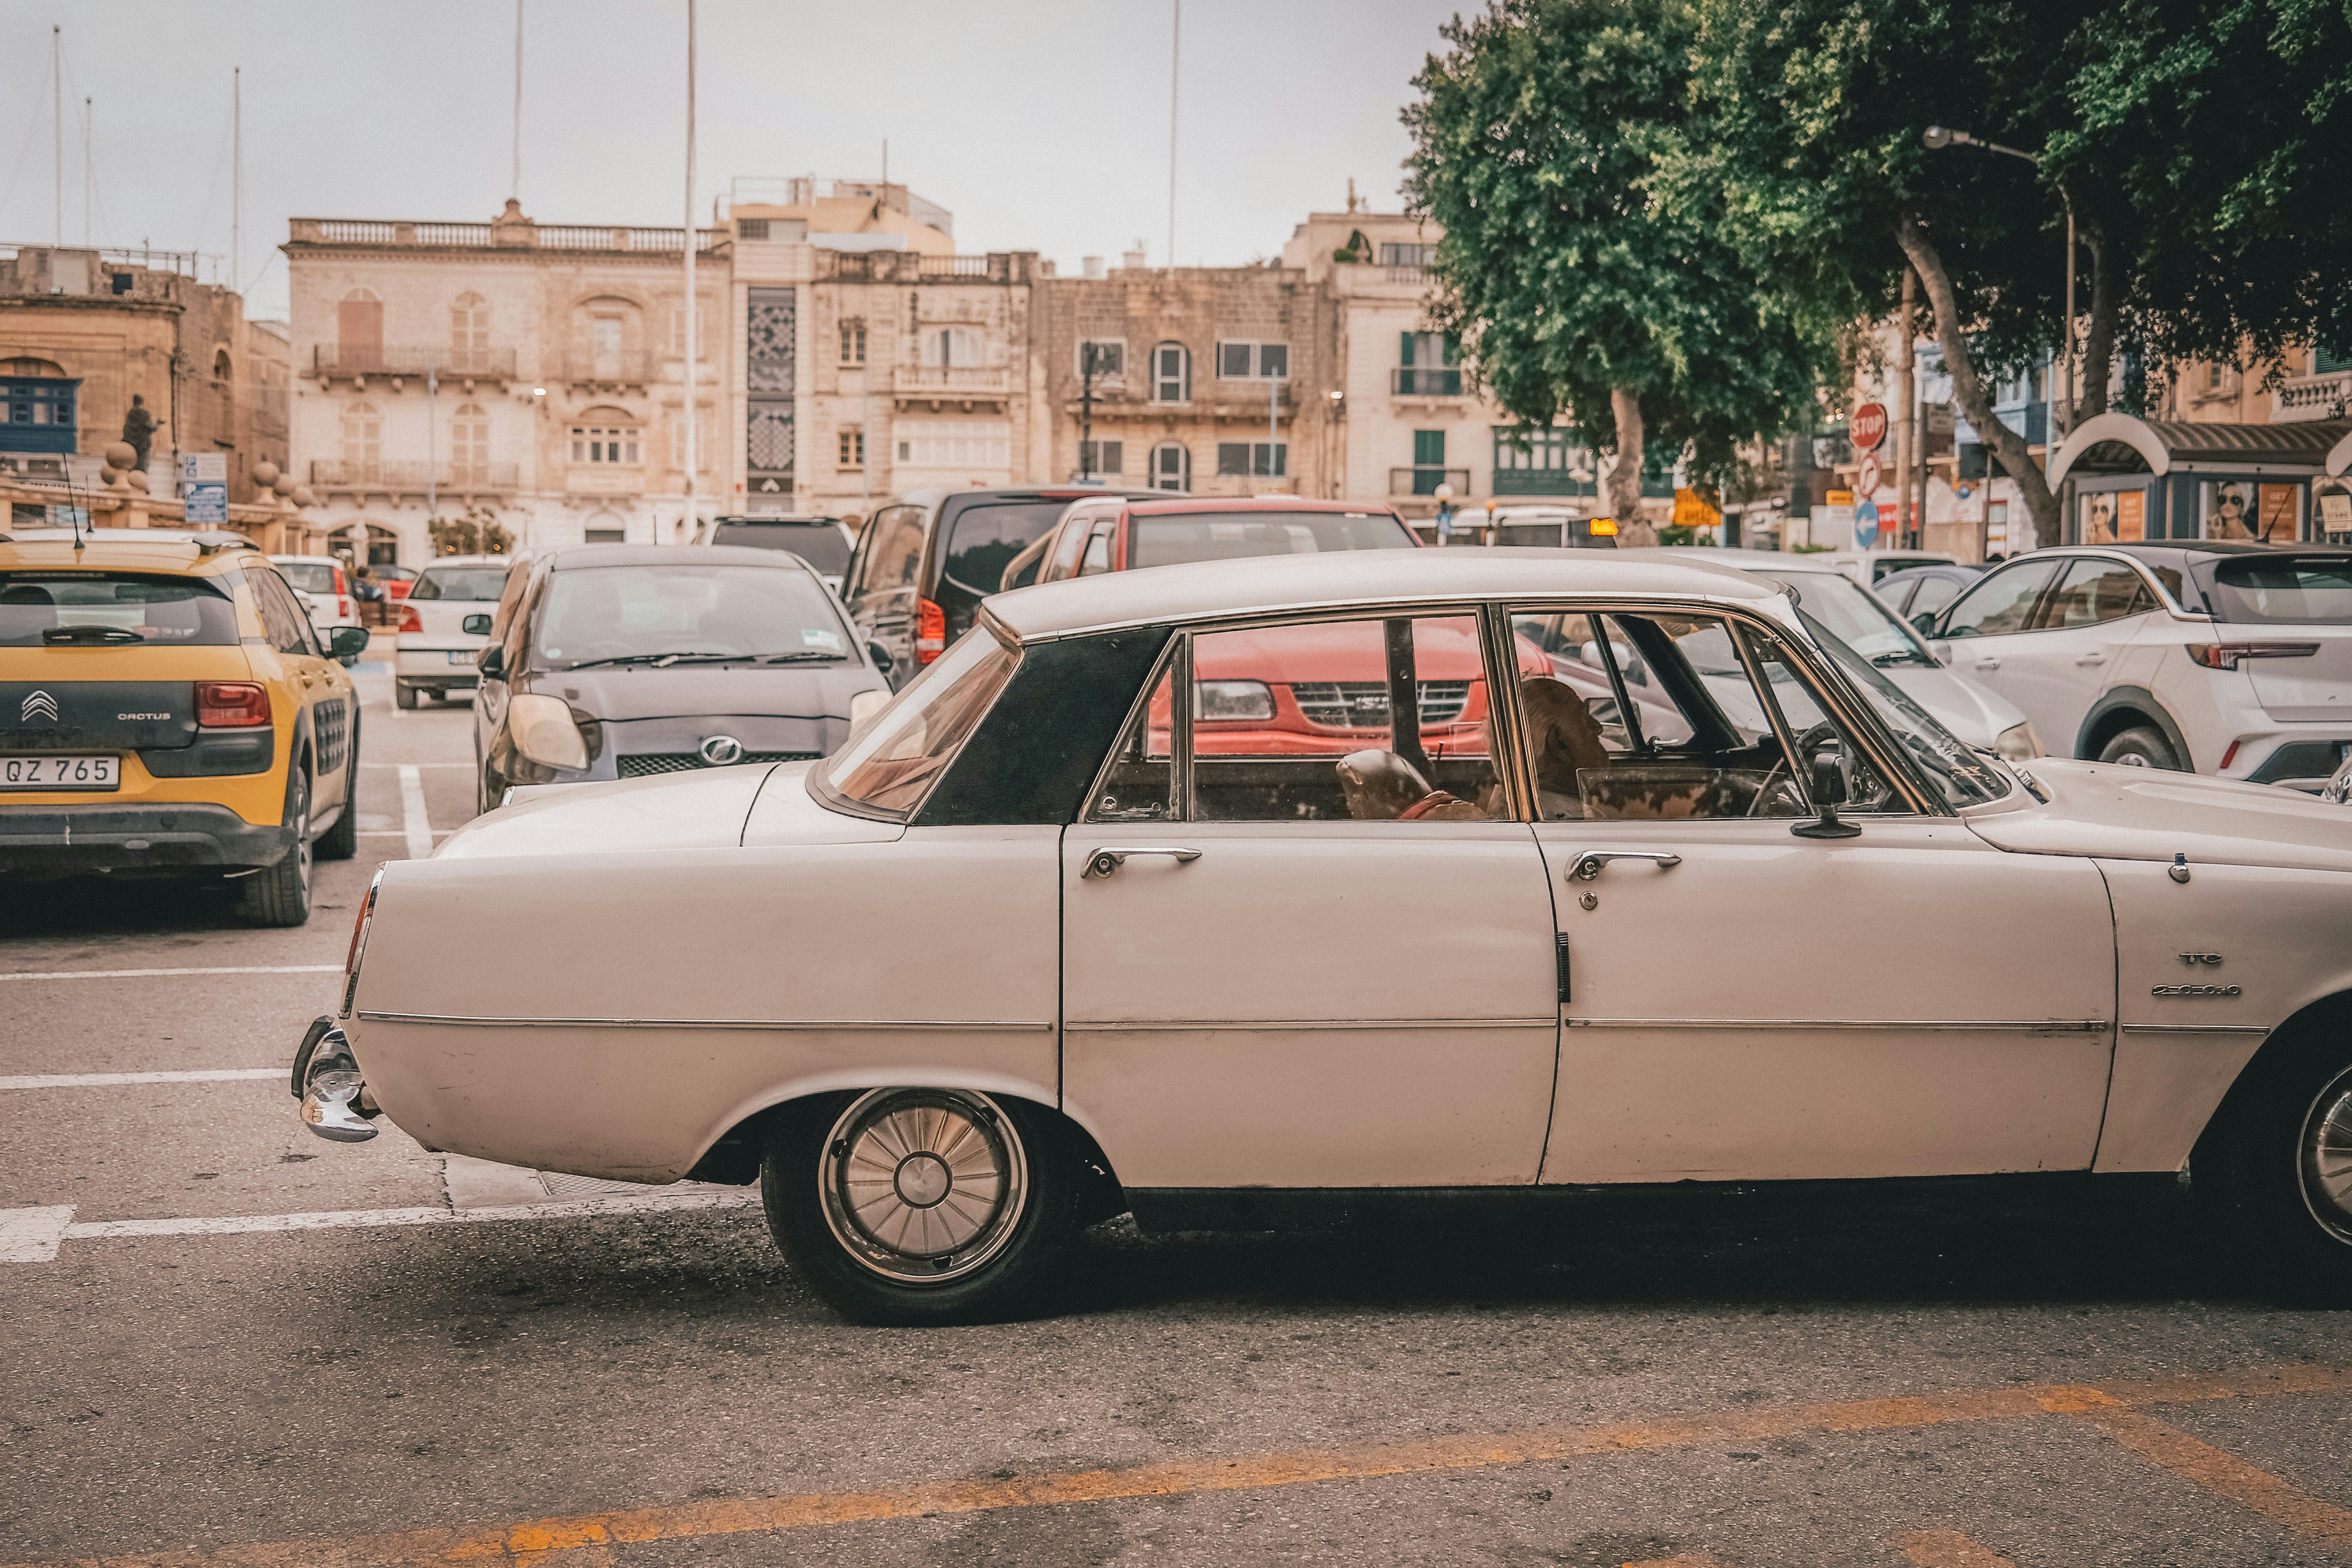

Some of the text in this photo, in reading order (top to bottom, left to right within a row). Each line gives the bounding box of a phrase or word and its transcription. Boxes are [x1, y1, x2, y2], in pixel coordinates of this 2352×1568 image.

[1852, 414, 1882, 437] STOP
[7, 760, 108, 781] QZ 765
[2179, 953, 2222, 964] TC
